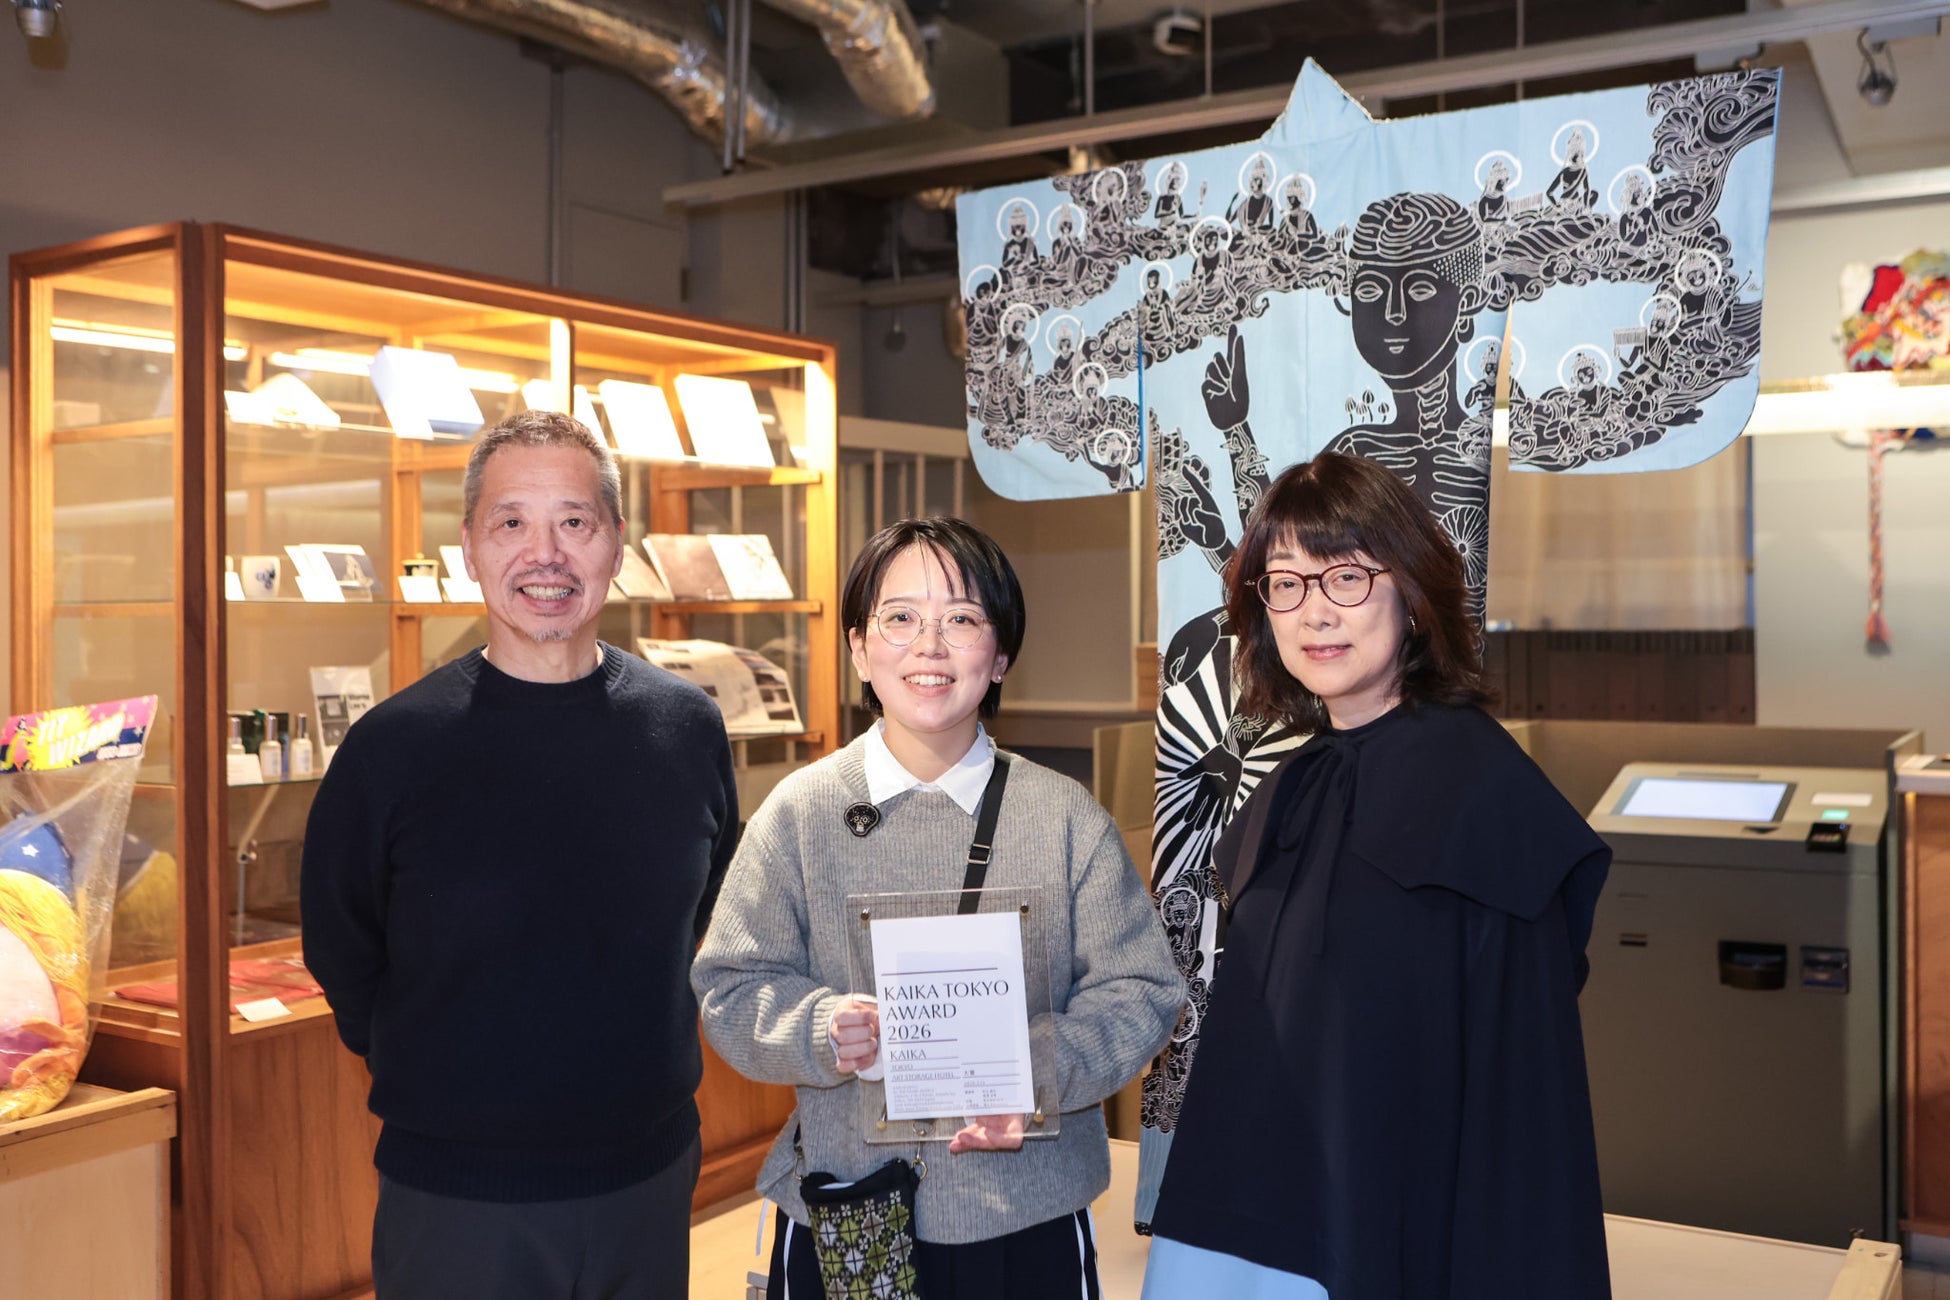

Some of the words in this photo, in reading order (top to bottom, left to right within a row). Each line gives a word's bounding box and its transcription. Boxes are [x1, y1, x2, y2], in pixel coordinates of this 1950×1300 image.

[884, 984, 939, 1001] KAIKA
[943, 980, 1009, 998] TOKYO
[886, 1003, 957, 1021] AWARD
[887, 1024, 931, 1041] 2026
[890, 1049, 927, 1061] KAIKA
